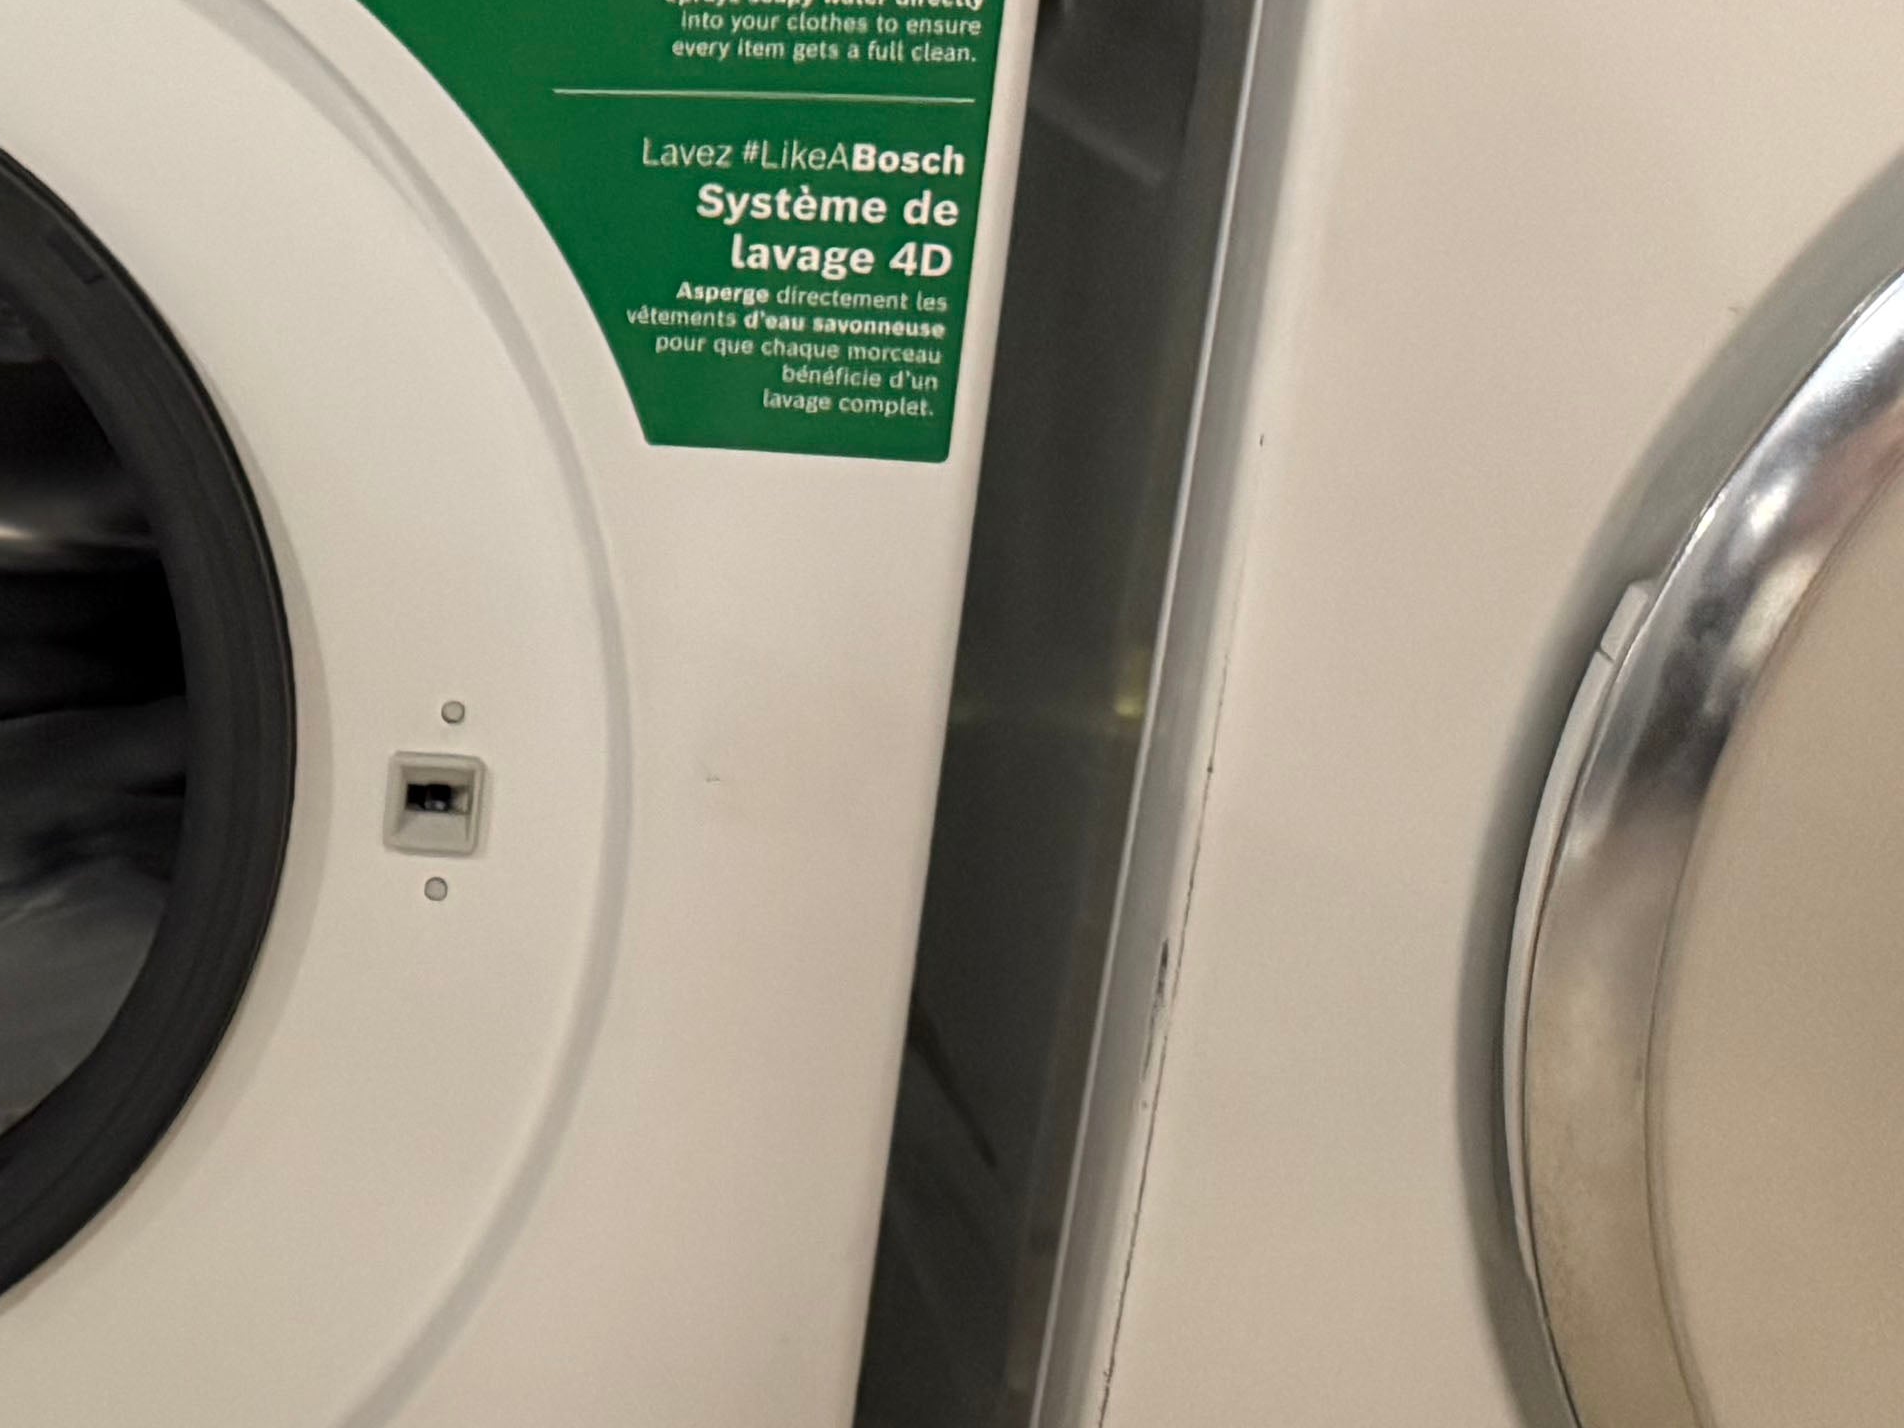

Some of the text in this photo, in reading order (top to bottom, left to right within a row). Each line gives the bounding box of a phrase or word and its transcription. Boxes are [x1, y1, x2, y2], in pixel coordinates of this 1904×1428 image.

[681, 11, 981, 35] into your clothes to ensure
[672, 39, 976, 62] every item gets a full clean.
[642, 138, 965, 175] Lavez #LikeABosch
[696, 183, 959, 226] Système de
[730, 234, 953, 280] lavage 4D
[676, 282, 948, 312] Asperge directement les
[626, 305, 945, 339] vêtements d'eau savonneuse
[655, 335, 942, 365] pour que chaque morceau
[782, 365, 938, 392] bénéficie d'un
[763, 389, 933, 418] lavage complet.
